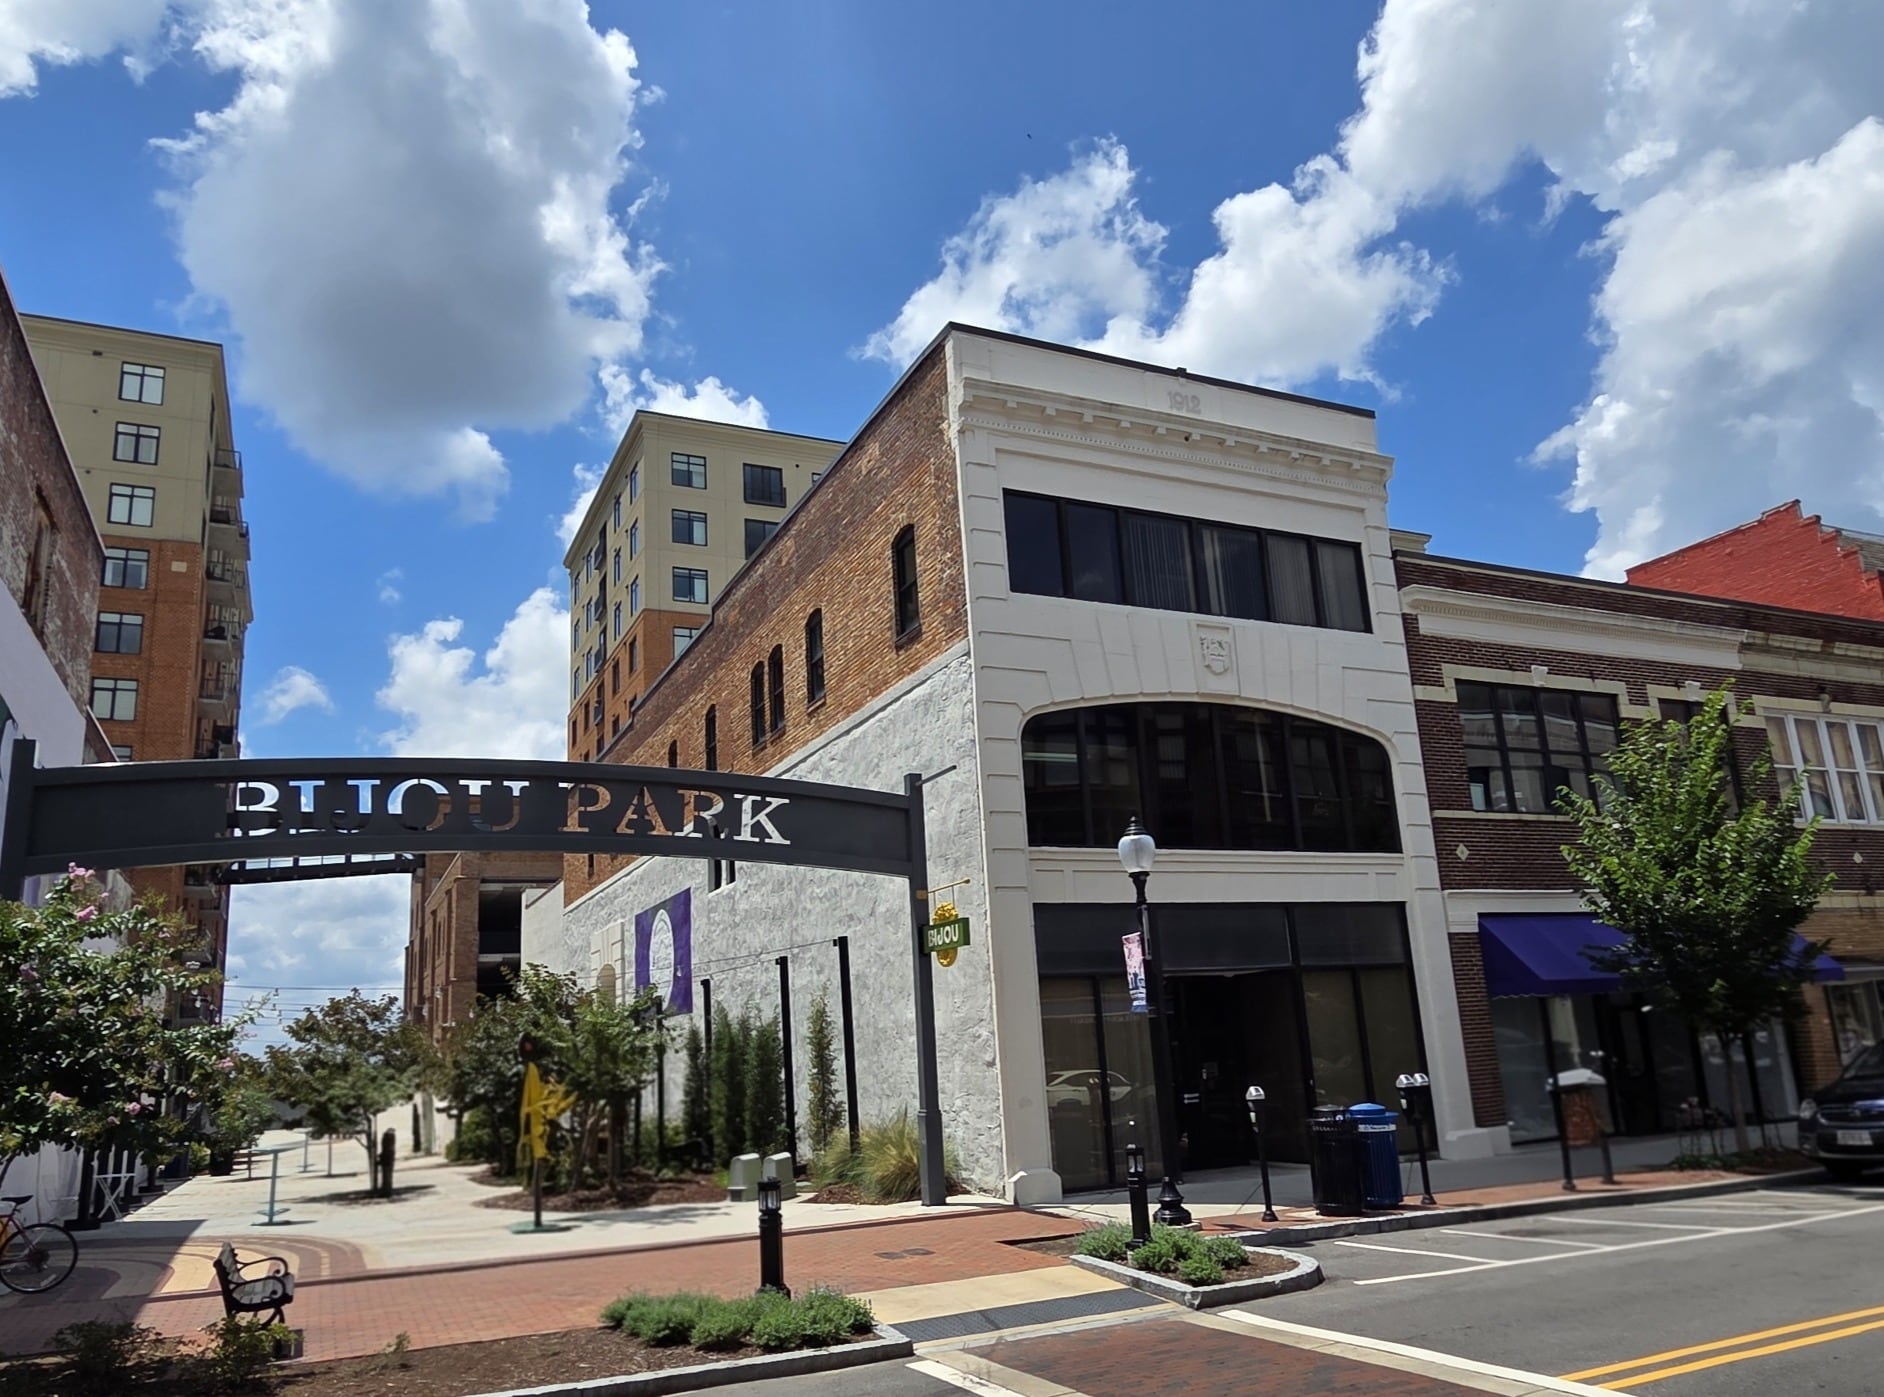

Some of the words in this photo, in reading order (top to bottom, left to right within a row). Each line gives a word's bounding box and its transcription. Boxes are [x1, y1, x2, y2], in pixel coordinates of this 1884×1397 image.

[1167, 390, 1202, 415] 1912
[214, 778, 530, 838] BIJOU
[558, 782, 791, 845] PARK
[927, 923, 959, 947] BIJOU
